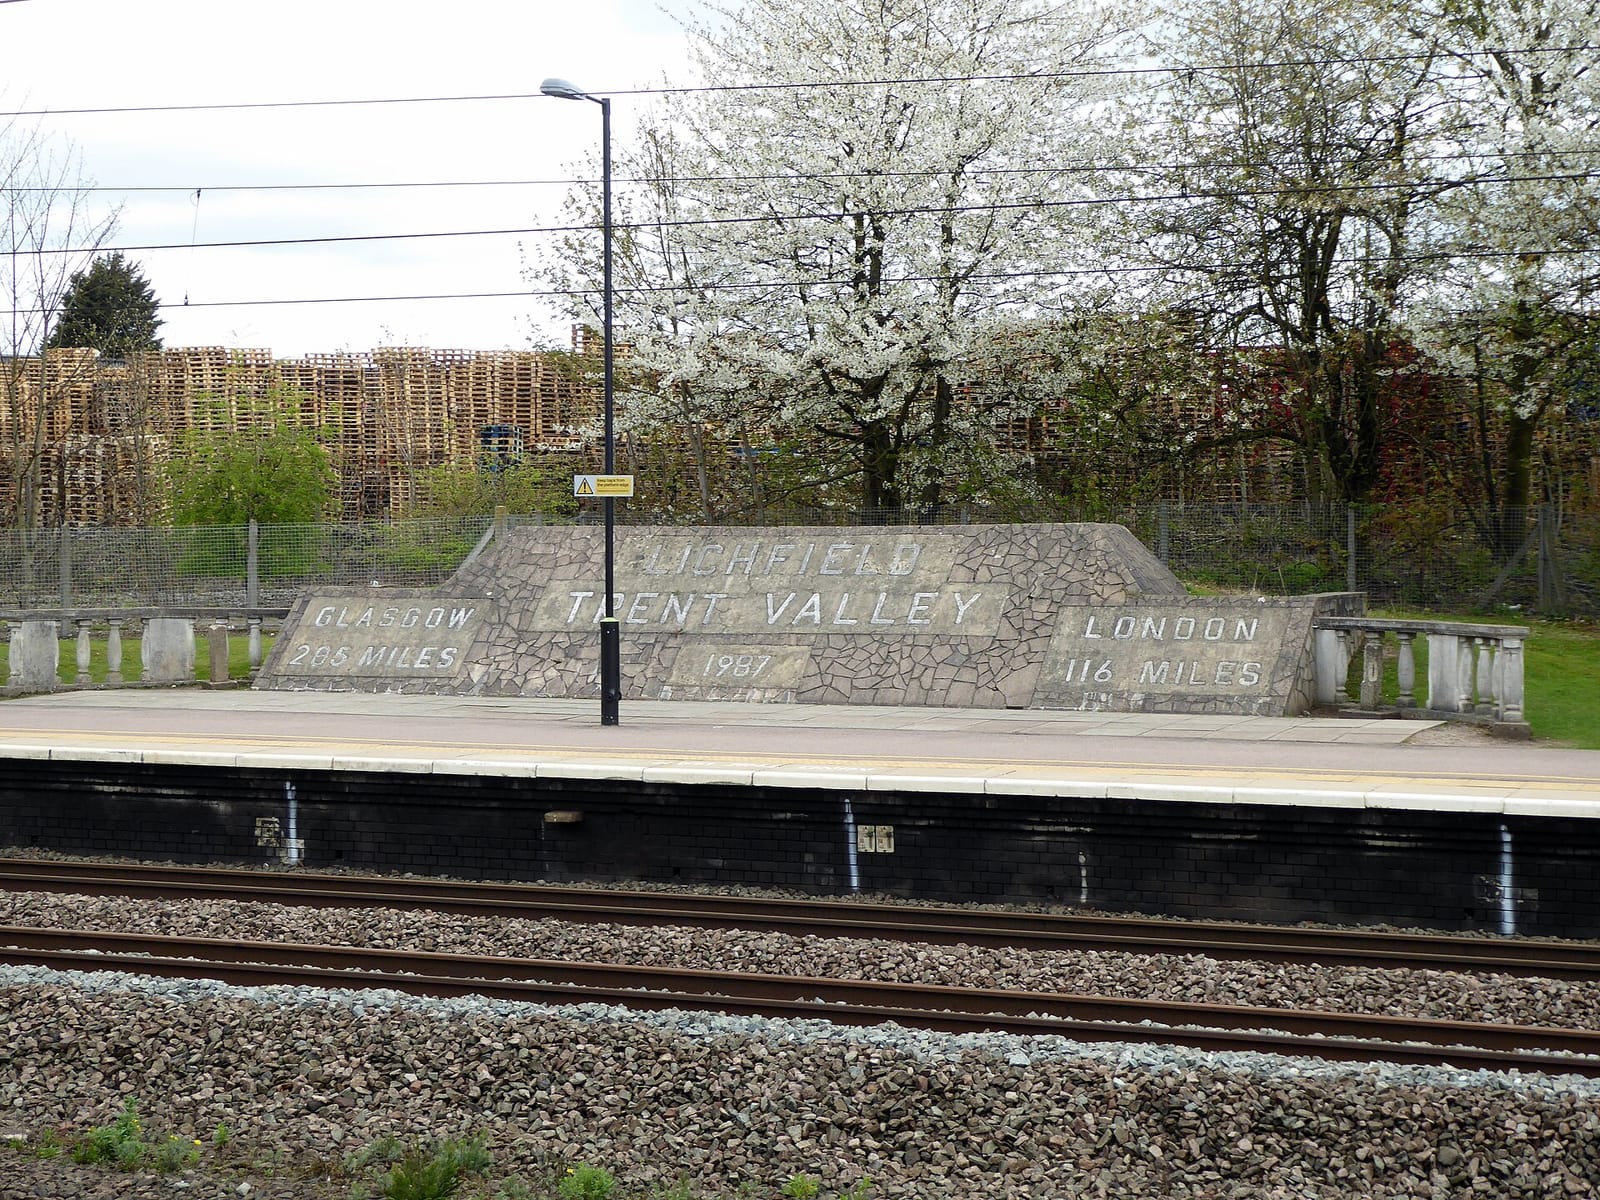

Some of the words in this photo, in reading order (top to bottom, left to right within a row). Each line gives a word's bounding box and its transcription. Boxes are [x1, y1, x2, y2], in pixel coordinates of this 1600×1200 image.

[645, 543, 923, 576] LICHFIELD
[315, 606, 475, 630] GLASGOW
[567, 591, 728, 625] TRENT
[766, 592, 982, 625] VALLEY
[1083, 616, 1259, 641] LONDON
[288, 645, 348, 668] 285
[358, 646, 459, 669] MILES
[703, 654, 772, 678] 1987
[1065, 659, 1113, 683] 116
[1139, 660, 1262, 686] MILES
